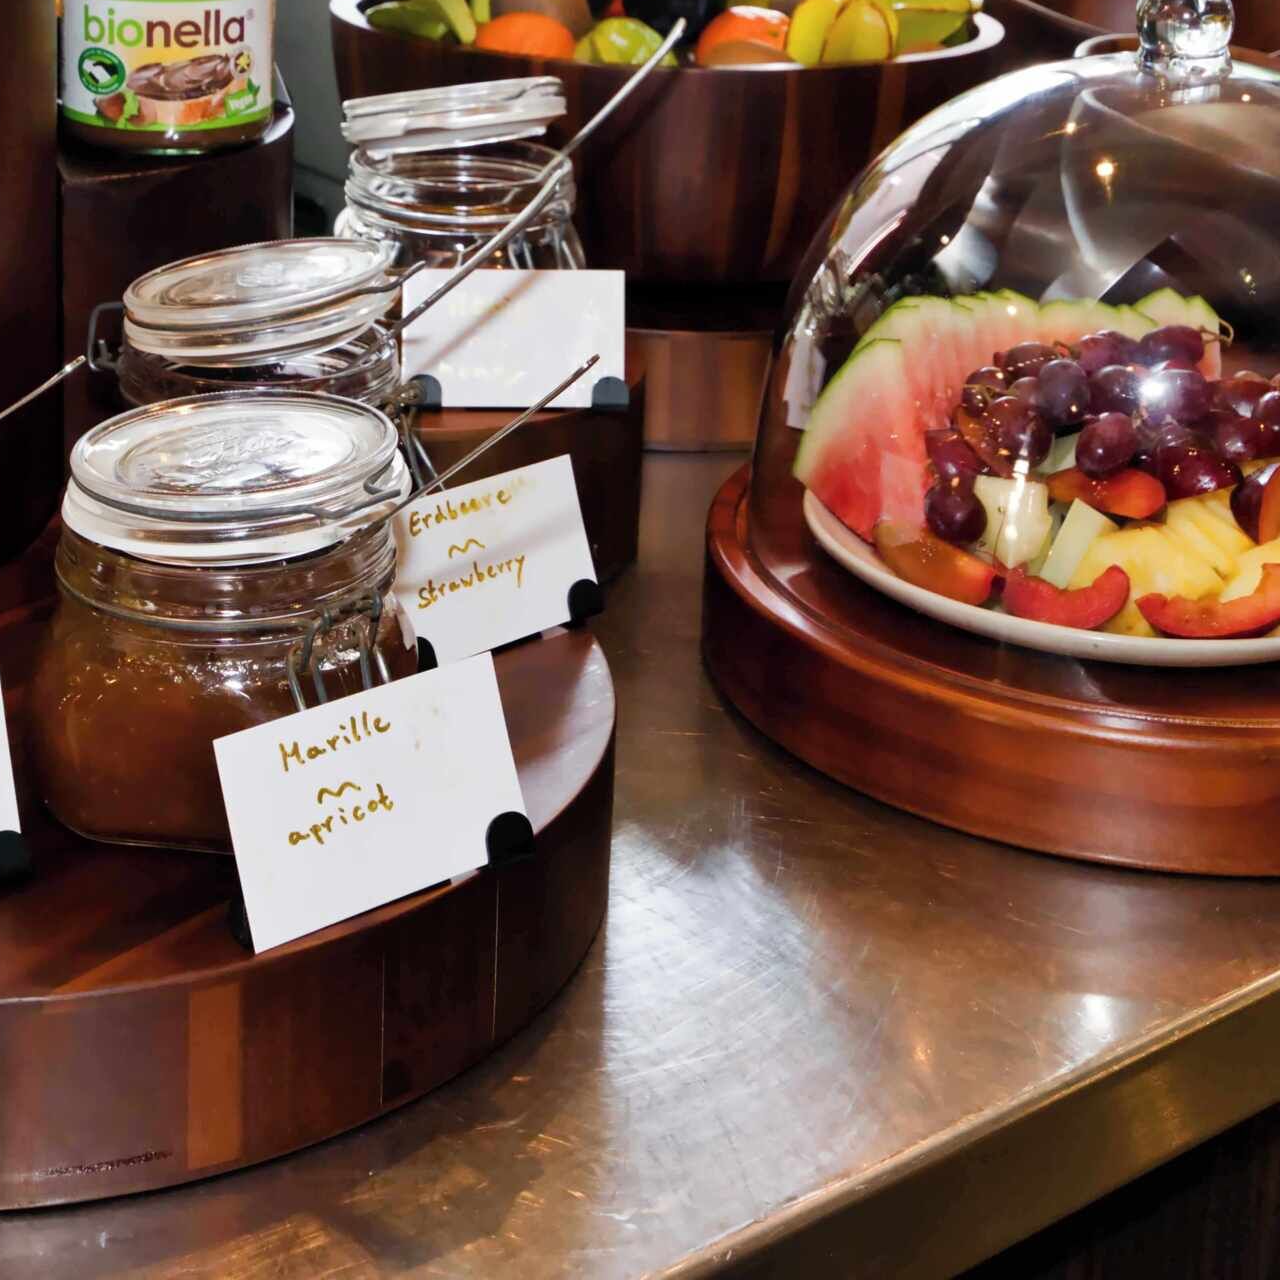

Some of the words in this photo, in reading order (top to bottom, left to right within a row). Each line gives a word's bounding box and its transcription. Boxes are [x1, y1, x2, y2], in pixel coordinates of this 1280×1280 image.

[83, 3, 246, 49] bionella
[278, 711, 391, 772] Marille
[287, 782, 394, 845] apricot
